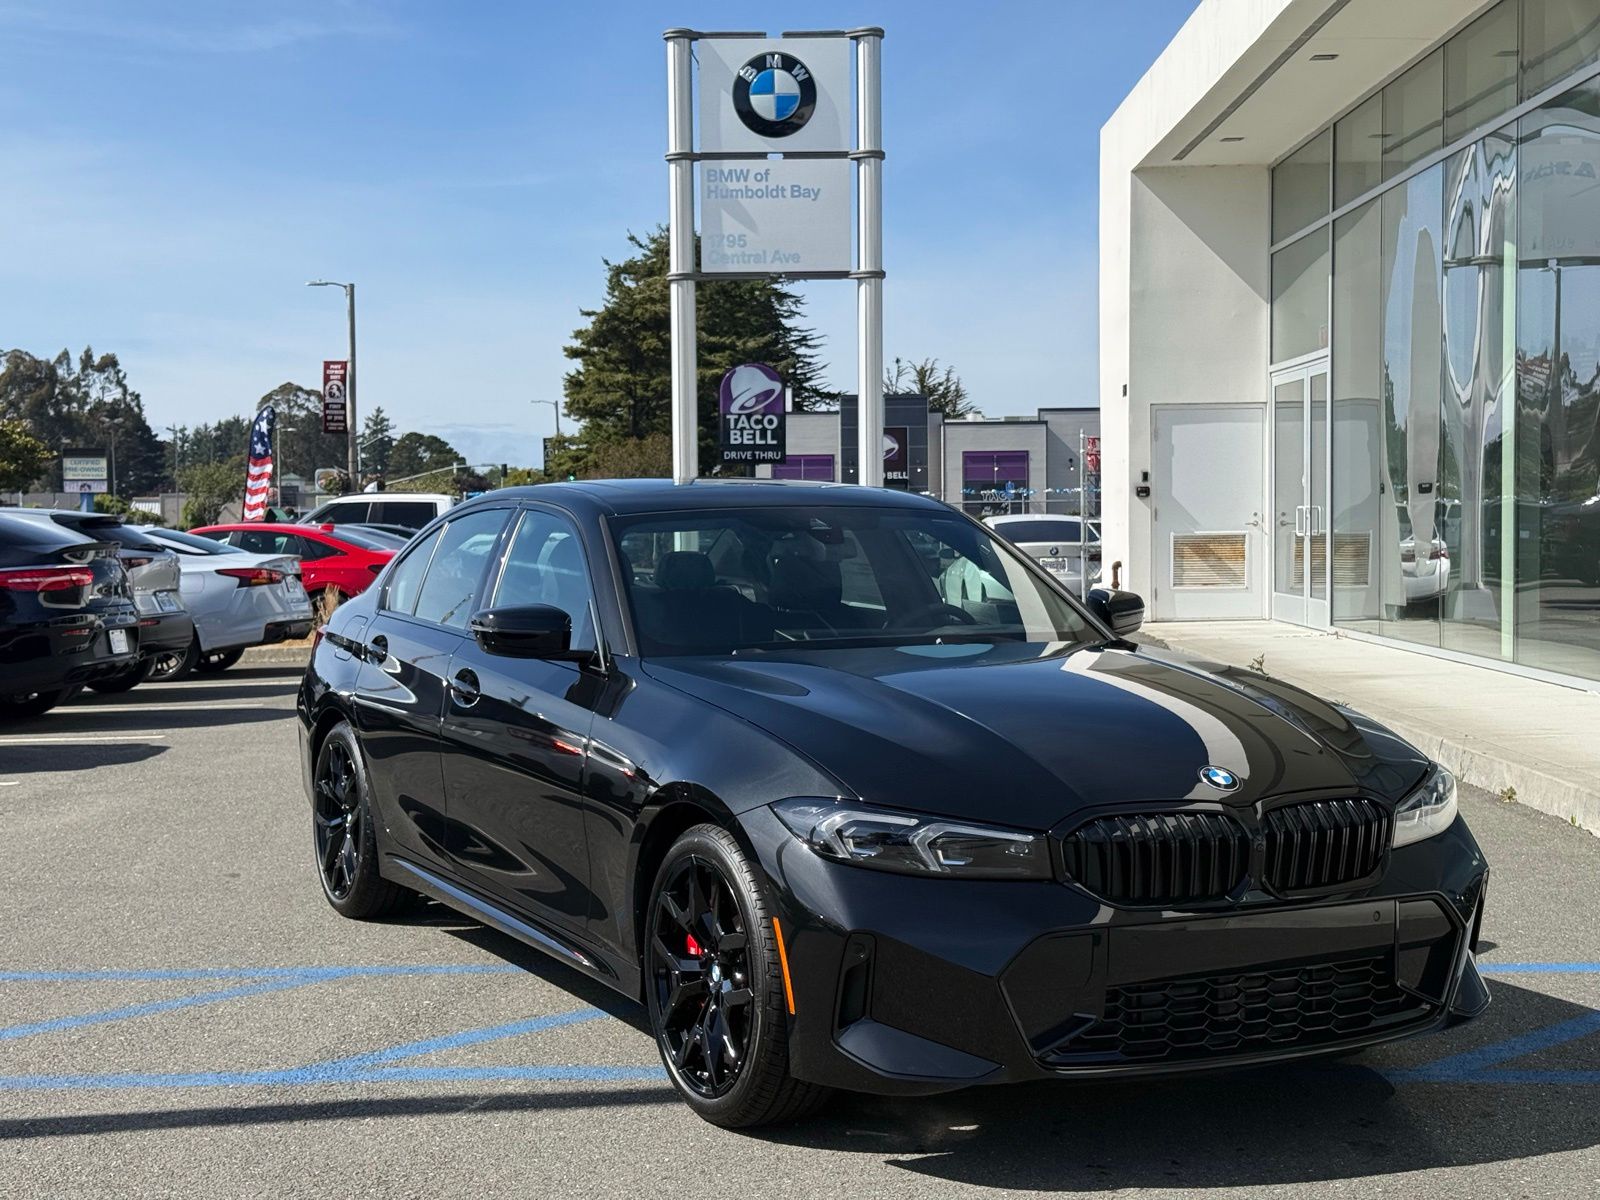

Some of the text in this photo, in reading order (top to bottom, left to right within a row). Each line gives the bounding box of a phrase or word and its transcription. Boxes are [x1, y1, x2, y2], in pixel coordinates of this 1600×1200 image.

[739, 54, 810, 83] BMW
[706, 168, 771, 183] BMW of
[706, 184, 821, 202] Humboldt Bay
[707, 250, 801, 264] Central Ave
[726, 414, 778, 430] TACO
[729, 430, 778, 445] BELL
[723, 451, 782, 460] DRIVE THRU
[886, 471, 909, 480] BELL
